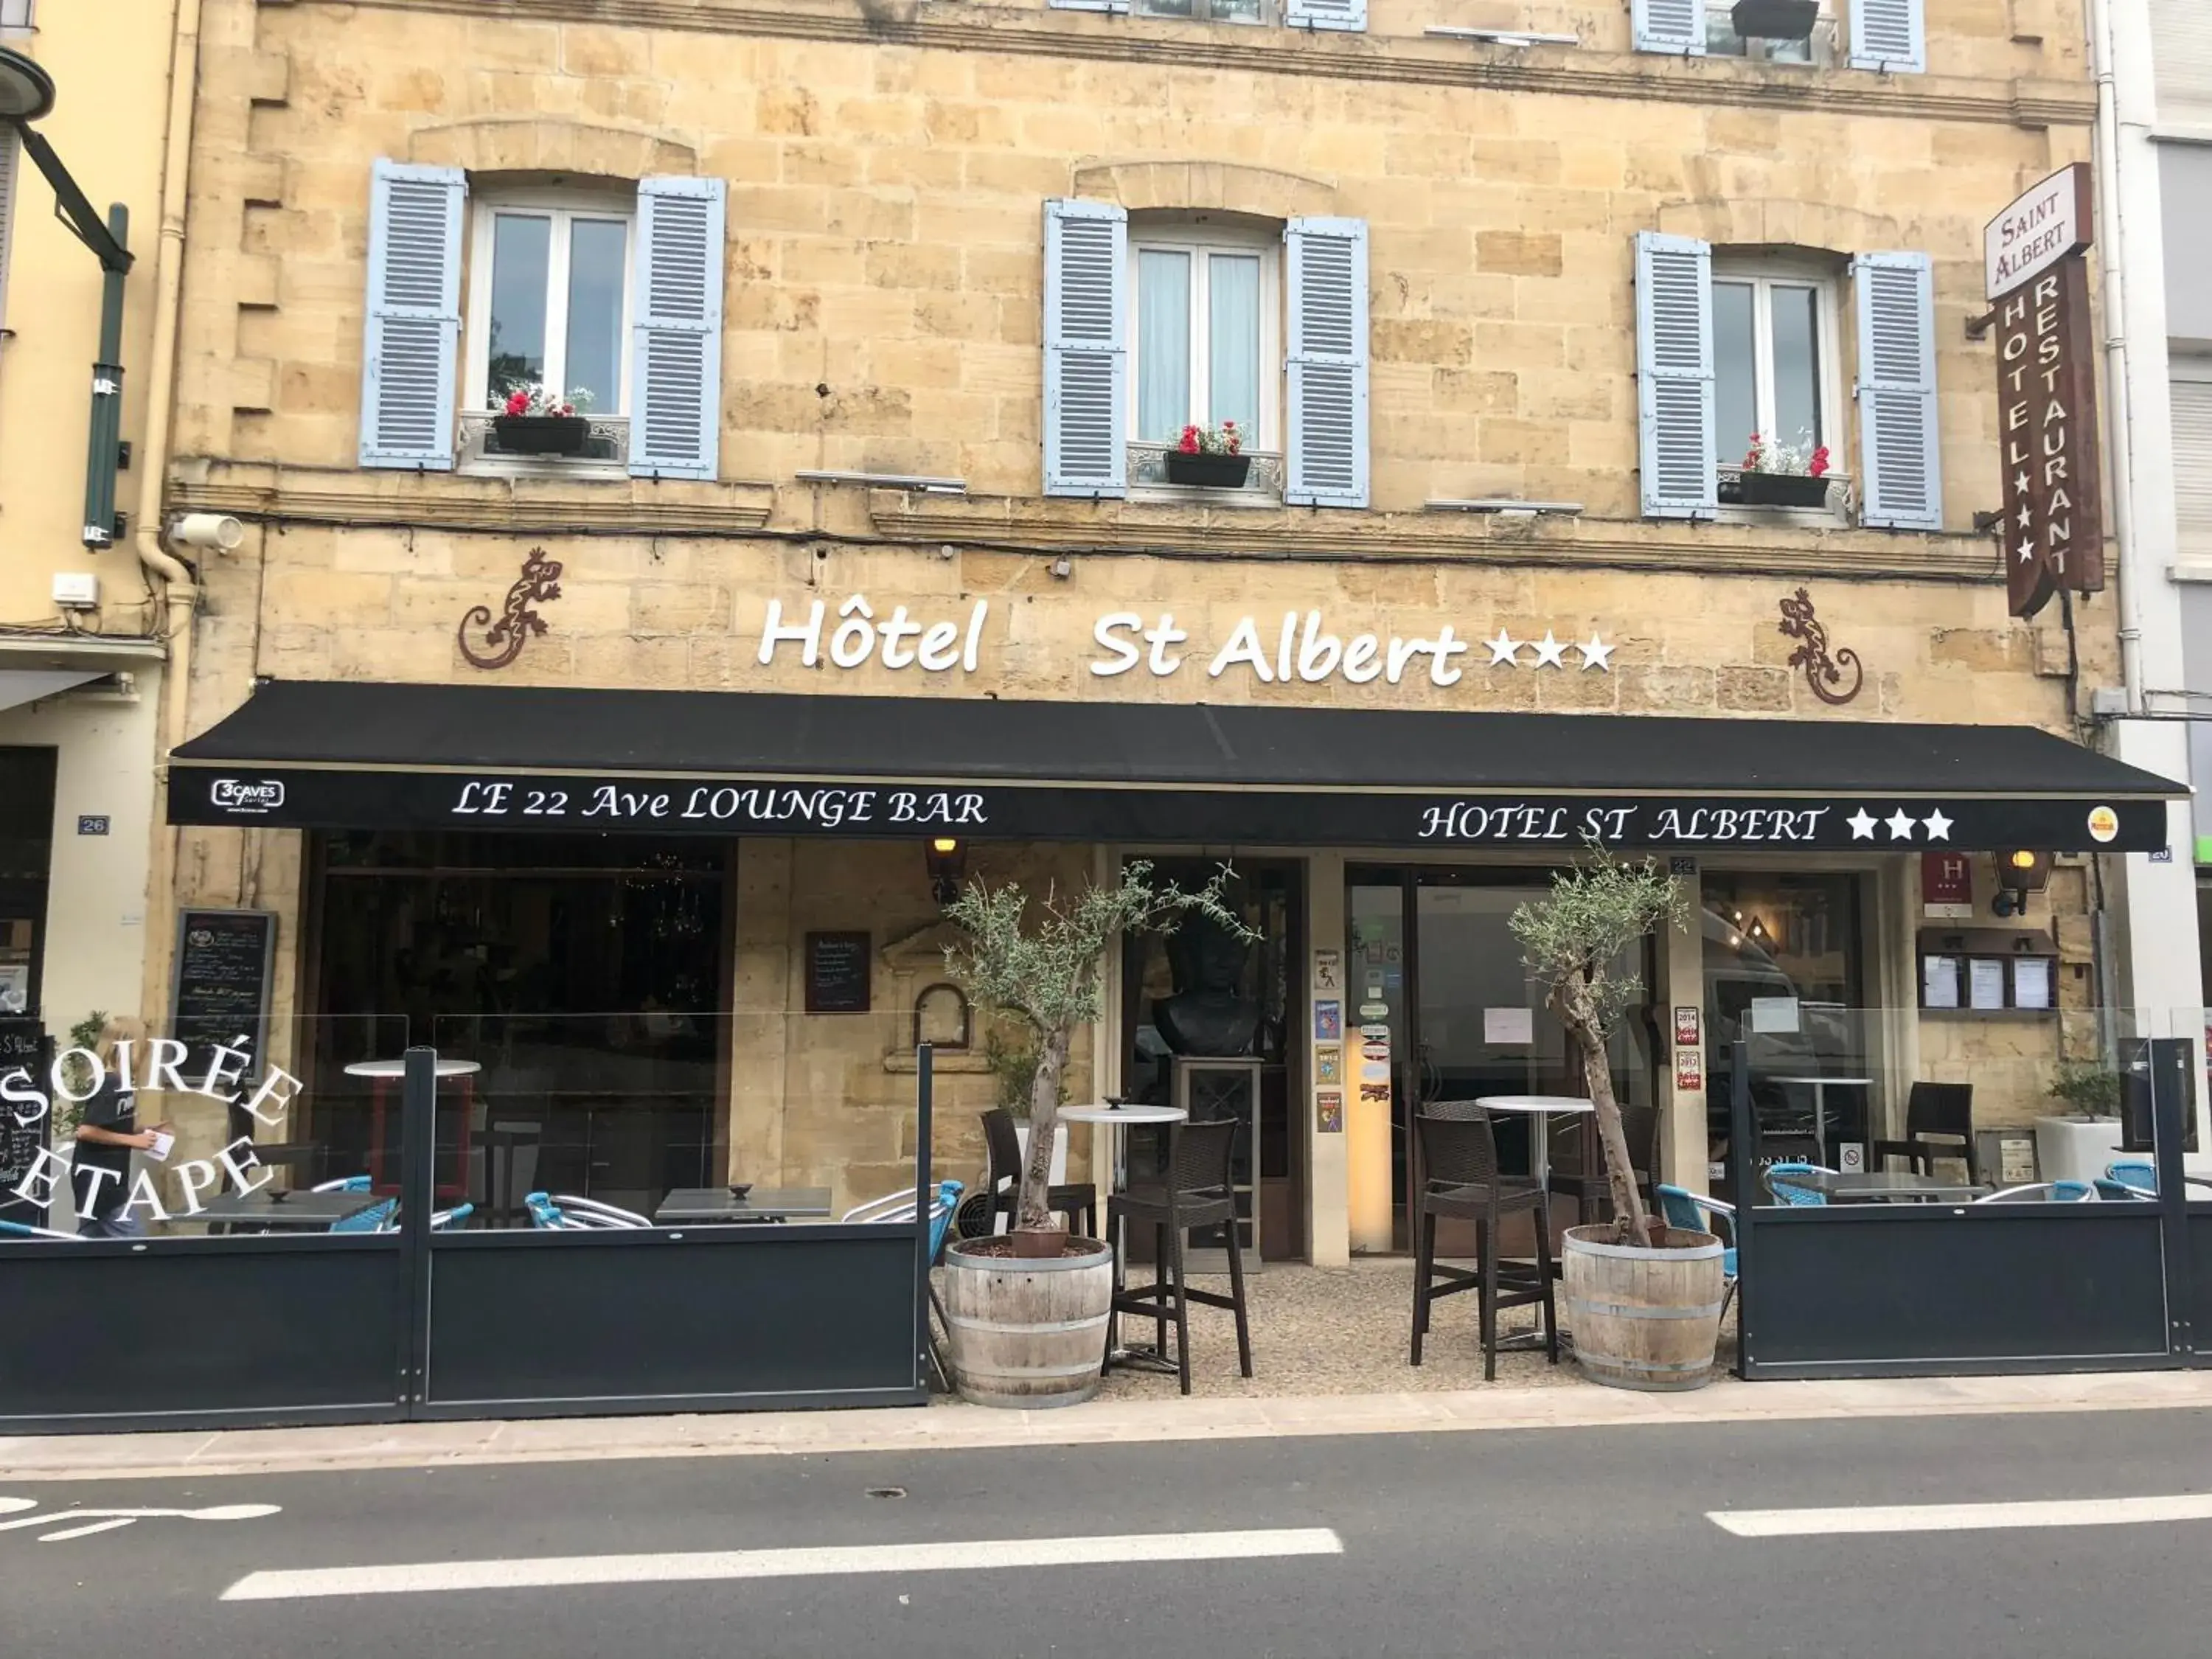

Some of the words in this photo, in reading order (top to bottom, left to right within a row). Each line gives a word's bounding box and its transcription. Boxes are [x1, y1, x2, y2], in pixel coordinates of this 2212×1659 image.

[2000, 192, 2059, 248] SAINT
[1994, 220, 2066, 285] ALBERT
[2003, 300, 2029, 467] HOTEL
[2034, 274, 2071, 576] RESTAURANT
[758, 595, 988, 672] Hôtel
[1091, 613, 1187, 675] St
[1208, 612, 1467, 686] Albert
[83, 819, 105, 832] 26
[451, 782, 514, 814] LE
[523, 791, 568, 815] 22
[581, 785, 669, 817] Ave
[681, 787, 877, 827] LOUNGE
[888, 792, 988, 824] BAR
[1418, 801, 1568, 838] HOTEL
[1577, 805, 1638, 840] ST
[1648, 806, 1830, 840] ALBERT
[1943, 860, 1963, 880] H
[1678, 1014, 1695, 1022] 2014
[0, 1034, 303, 1127] SOIRÉE
